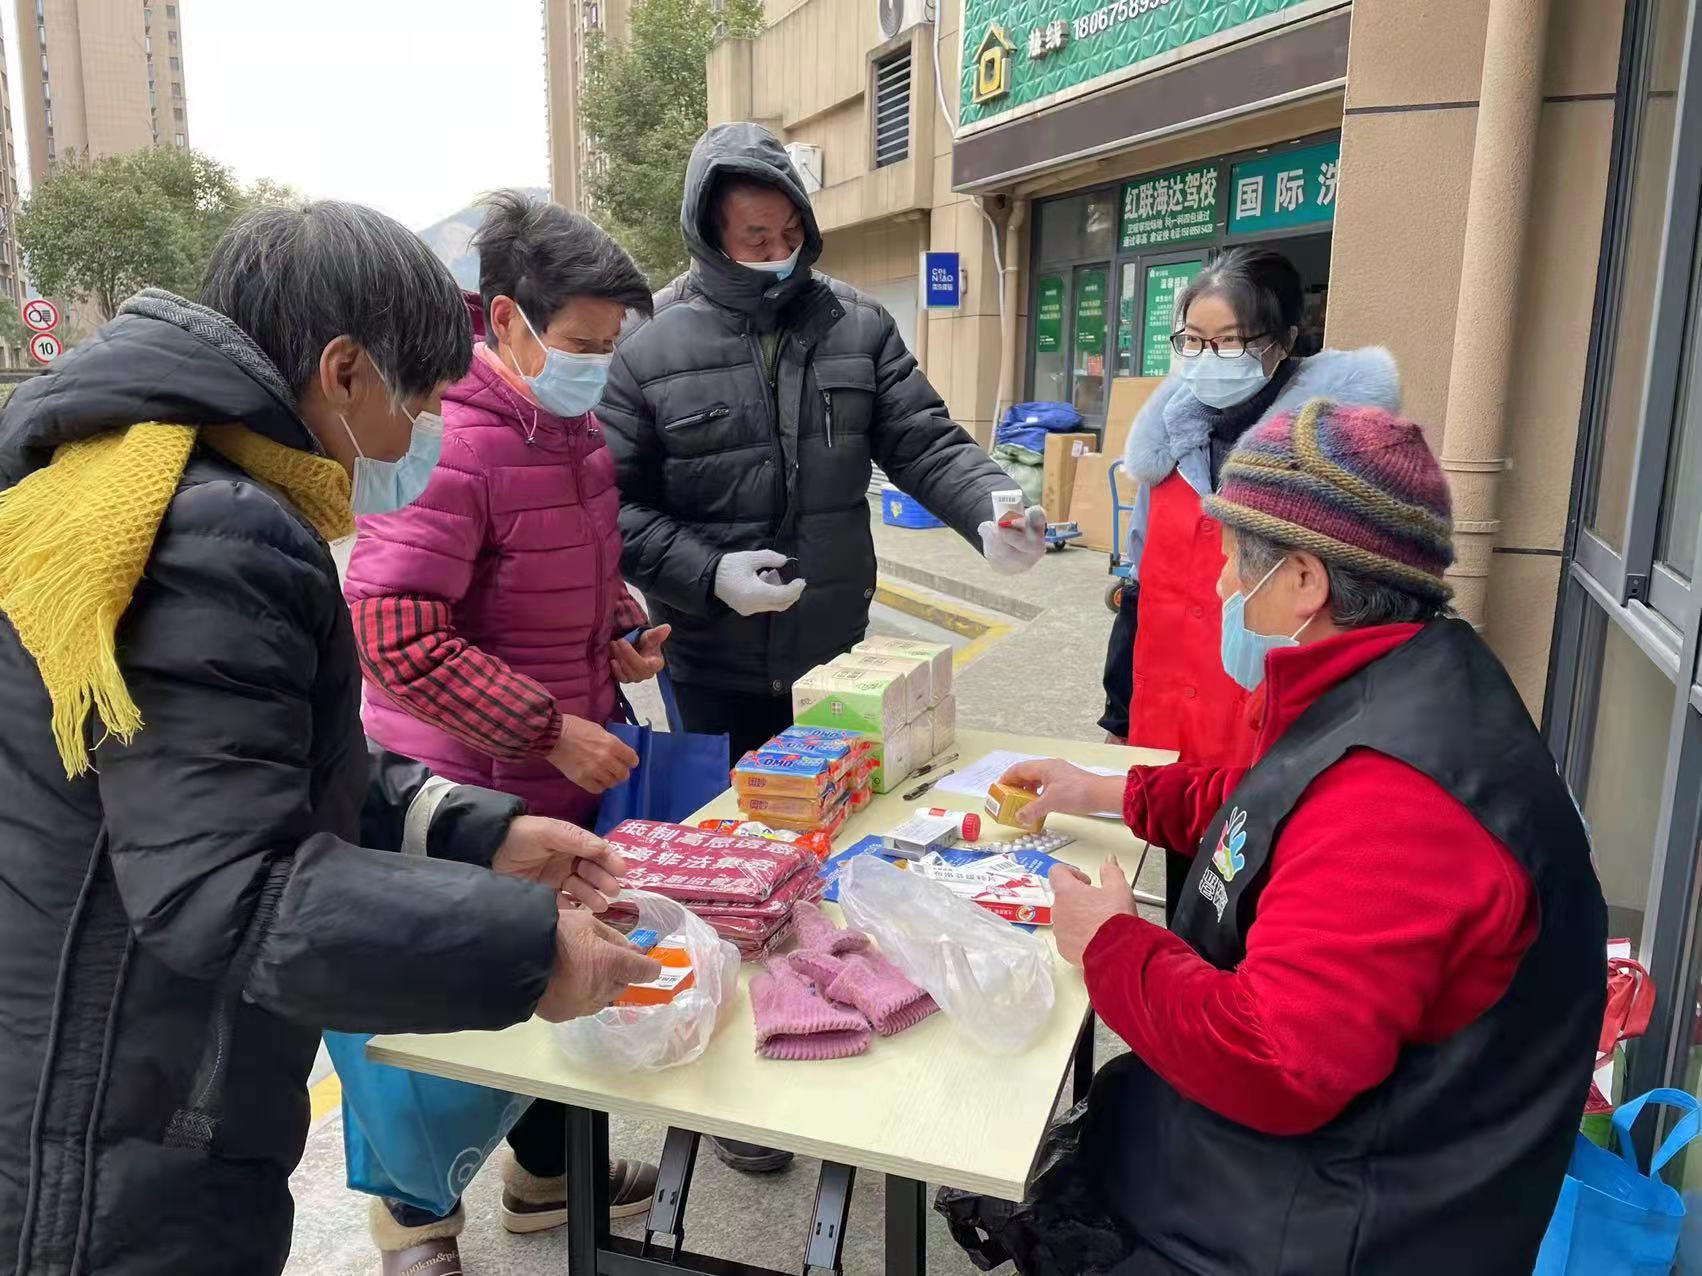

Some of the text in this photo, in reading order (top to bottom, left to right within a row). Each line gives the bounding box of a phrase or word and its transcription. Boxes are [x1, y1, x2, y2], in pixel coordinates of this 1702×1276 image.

[1124, 168, 1217, 219] 红联海达驾校
[1236, 159, 1339, 220] 国际洗
[38, 342, 54, 355] 10
[763, 758, 794, 768] OMO
[617, 821, 797, 856] 抵制高息诱惑
